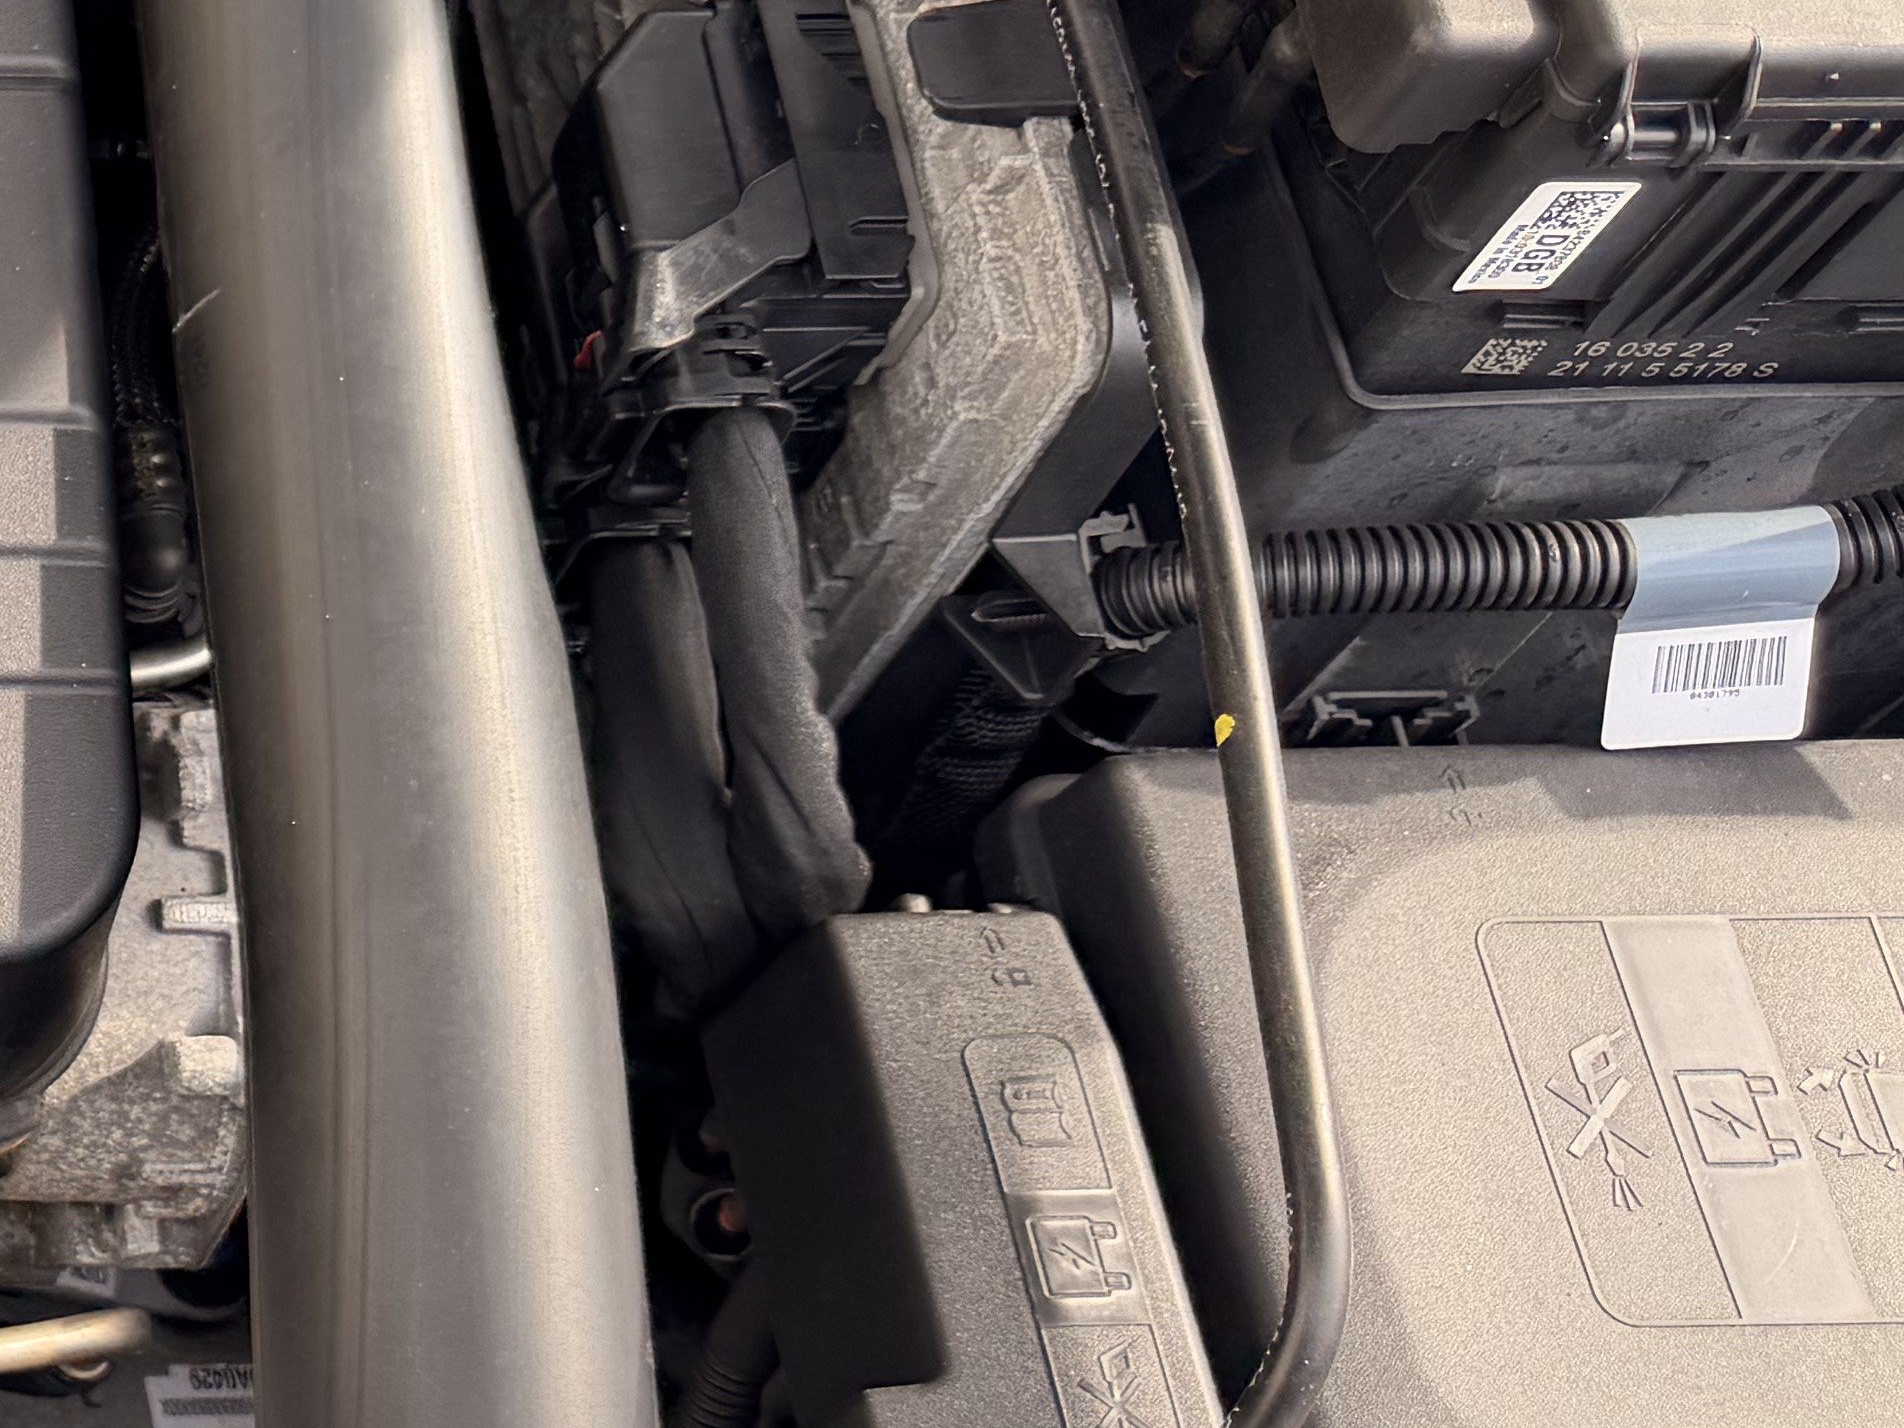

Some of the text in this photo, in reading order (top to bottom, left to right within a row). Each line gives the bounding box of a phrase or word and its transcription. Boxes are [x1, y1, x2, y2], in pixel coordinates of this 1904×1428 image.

[1511, 234, 1571, 272] DGB
[1572, 340, 1734, 358] 16 035 2 2
[1547, 361, 1586, 377] 21
[1640, 362, 1664, 377] 5
[1668, 362, 1744, 377] 5178
